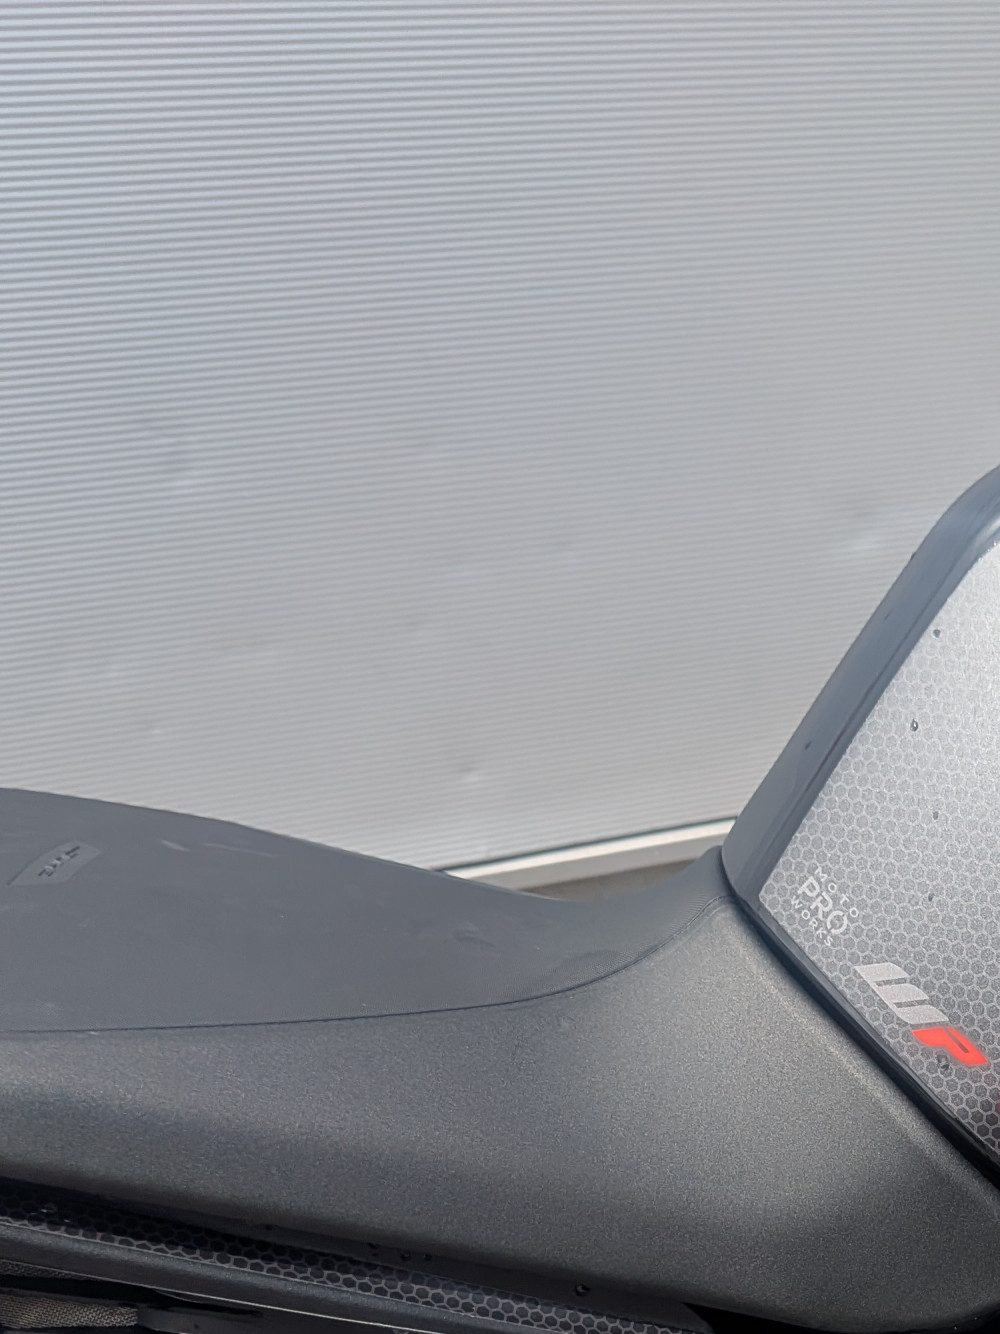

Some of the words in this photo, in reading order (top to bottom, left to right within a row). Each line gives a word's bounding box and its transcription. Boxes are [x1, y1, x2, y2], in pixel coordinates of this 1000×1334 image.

[798, 876, 848, 935] PRO
[813, 866, 859, 918] MOTO
[790, 895, 834, 947] WORKS
